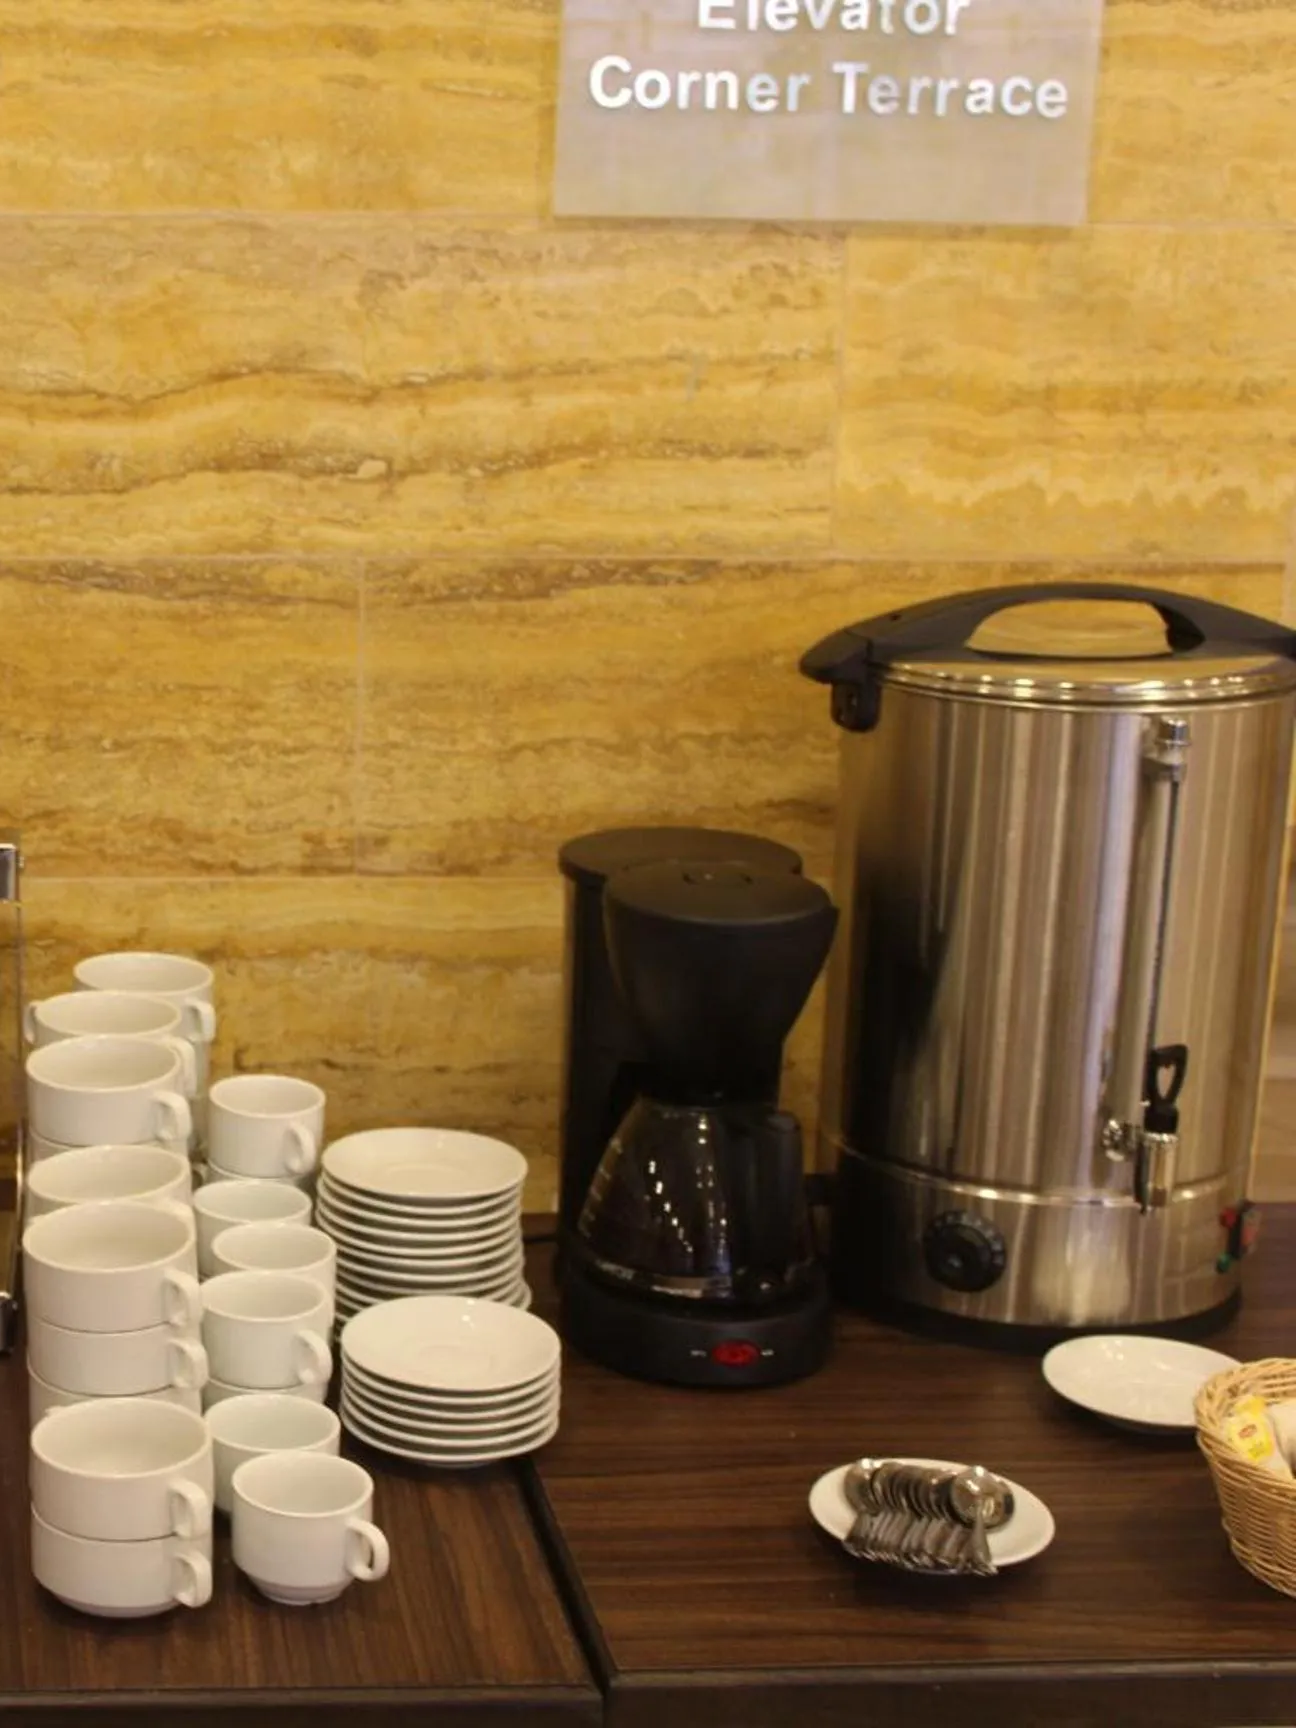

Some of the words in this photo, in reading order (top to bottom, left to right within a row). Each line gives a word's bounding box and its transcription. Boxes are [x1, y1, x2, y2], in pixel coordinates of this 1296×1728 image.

[698, 0, 971, 35] Elevator
[589, 54, 812, 112] Corner
[831, 61, 1069, 118] Terrace
